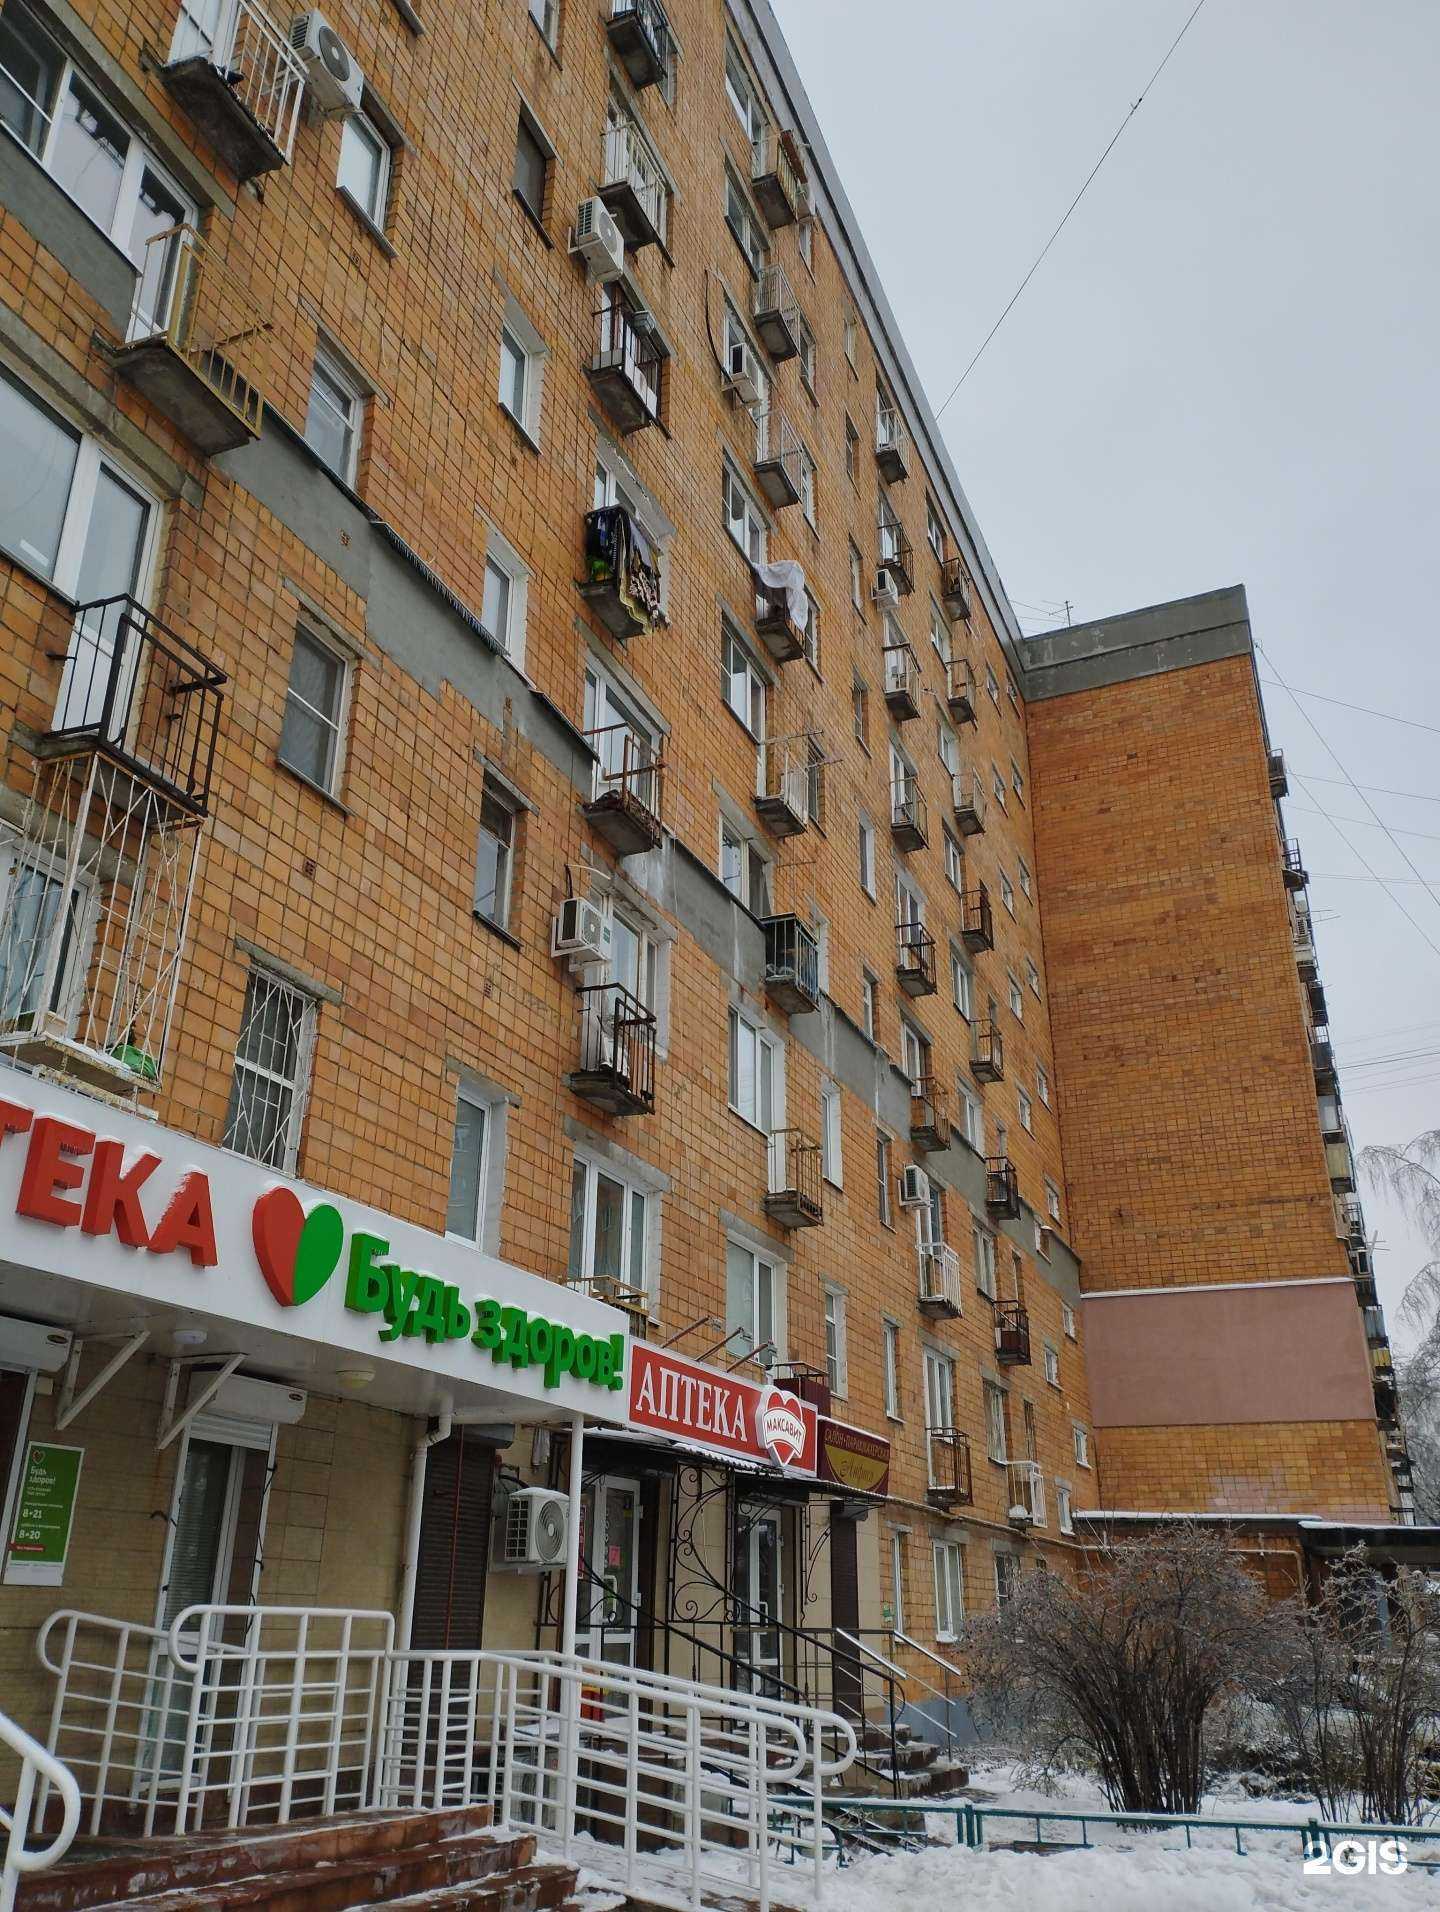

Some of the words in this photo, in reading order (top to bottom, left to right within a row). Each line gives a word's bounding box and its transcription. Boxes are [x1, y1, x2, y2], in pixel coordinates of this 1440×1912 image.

[344, 1232, 471, 1343] Будь
[471, 1298, 625, 1392] здоров!
[635, 1361, 748, 1442] АПТЕКА
[766, 1418, 804, 1444] МАКСАВИТ
